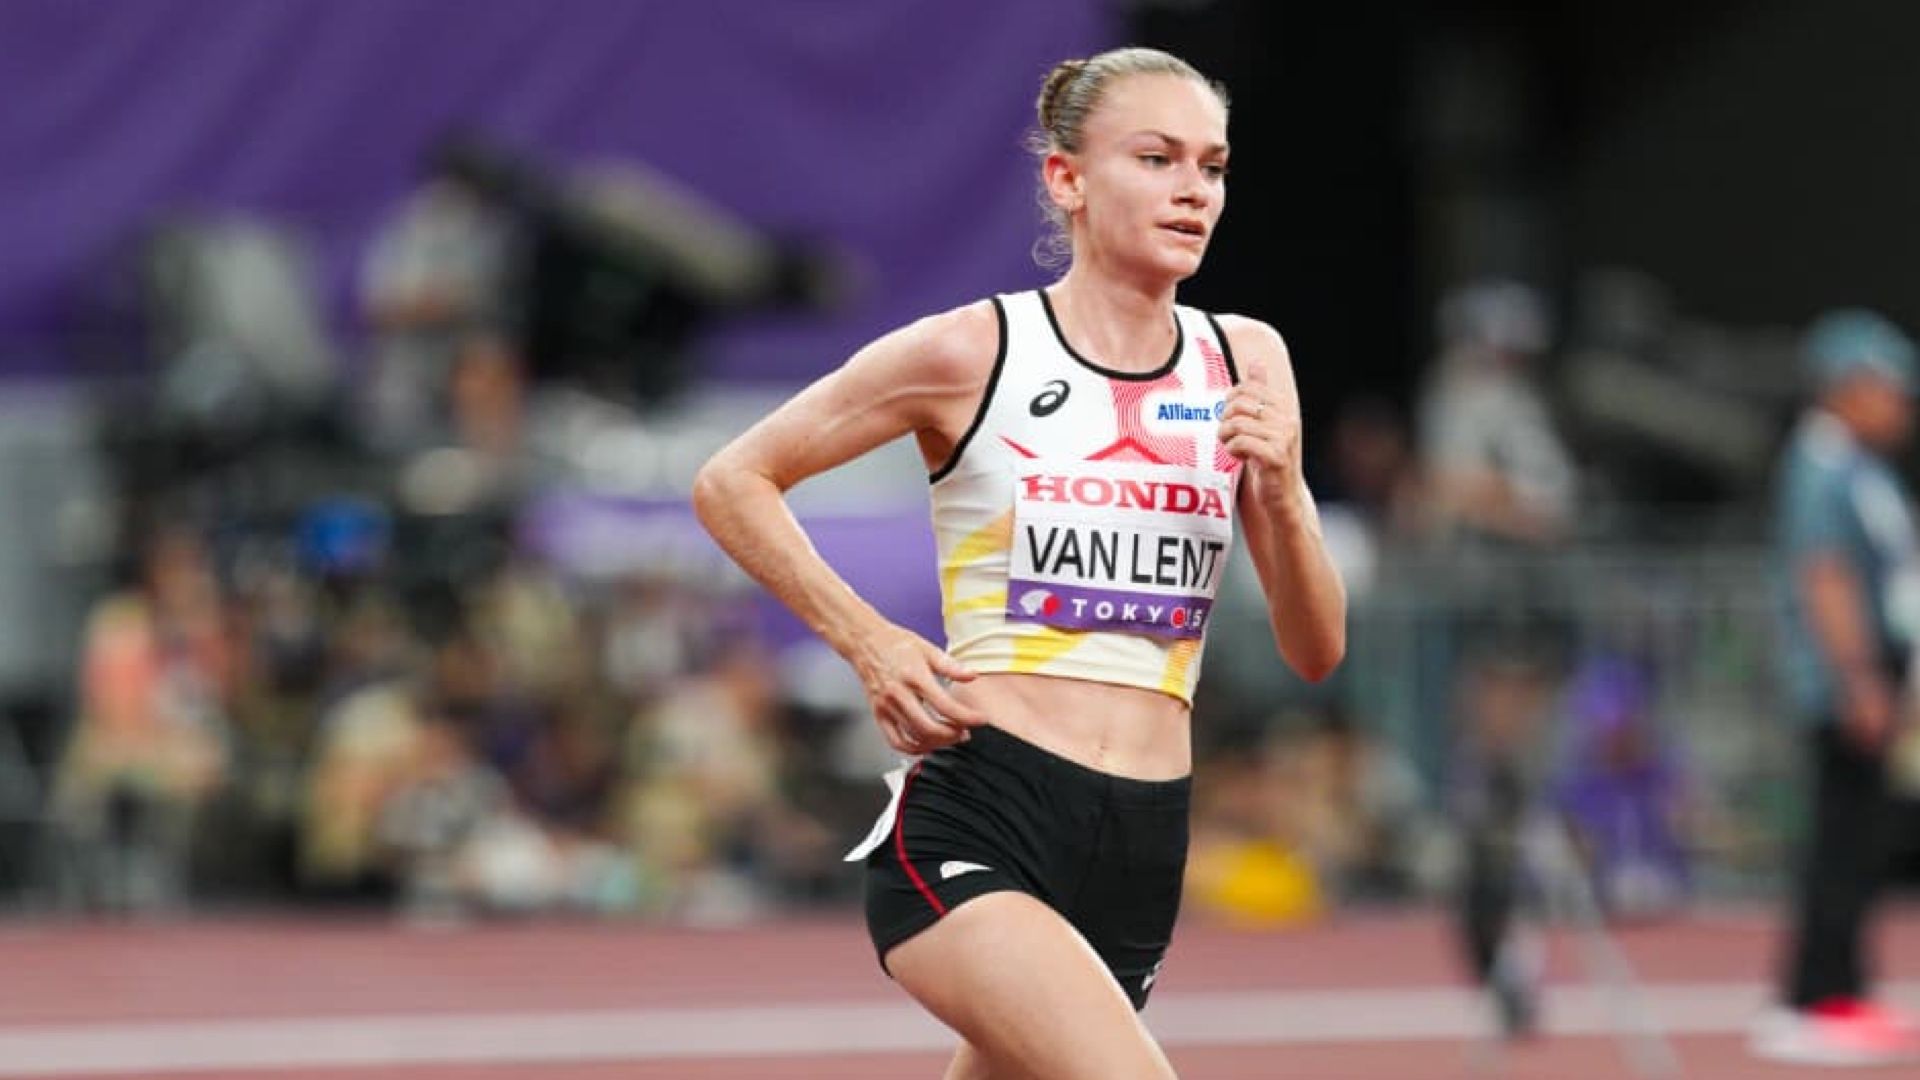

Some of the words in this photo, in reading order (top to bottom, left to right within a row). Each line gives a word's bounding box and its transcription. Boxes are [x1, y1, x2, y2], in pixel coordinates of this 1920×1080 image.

[1158, 402, 1212, 421] Allianz
[1021, 474, 1227, 518] HONDA
[1027, 525, 1119, 580] VAN
[1131, 533, 1224, 590] LENT
